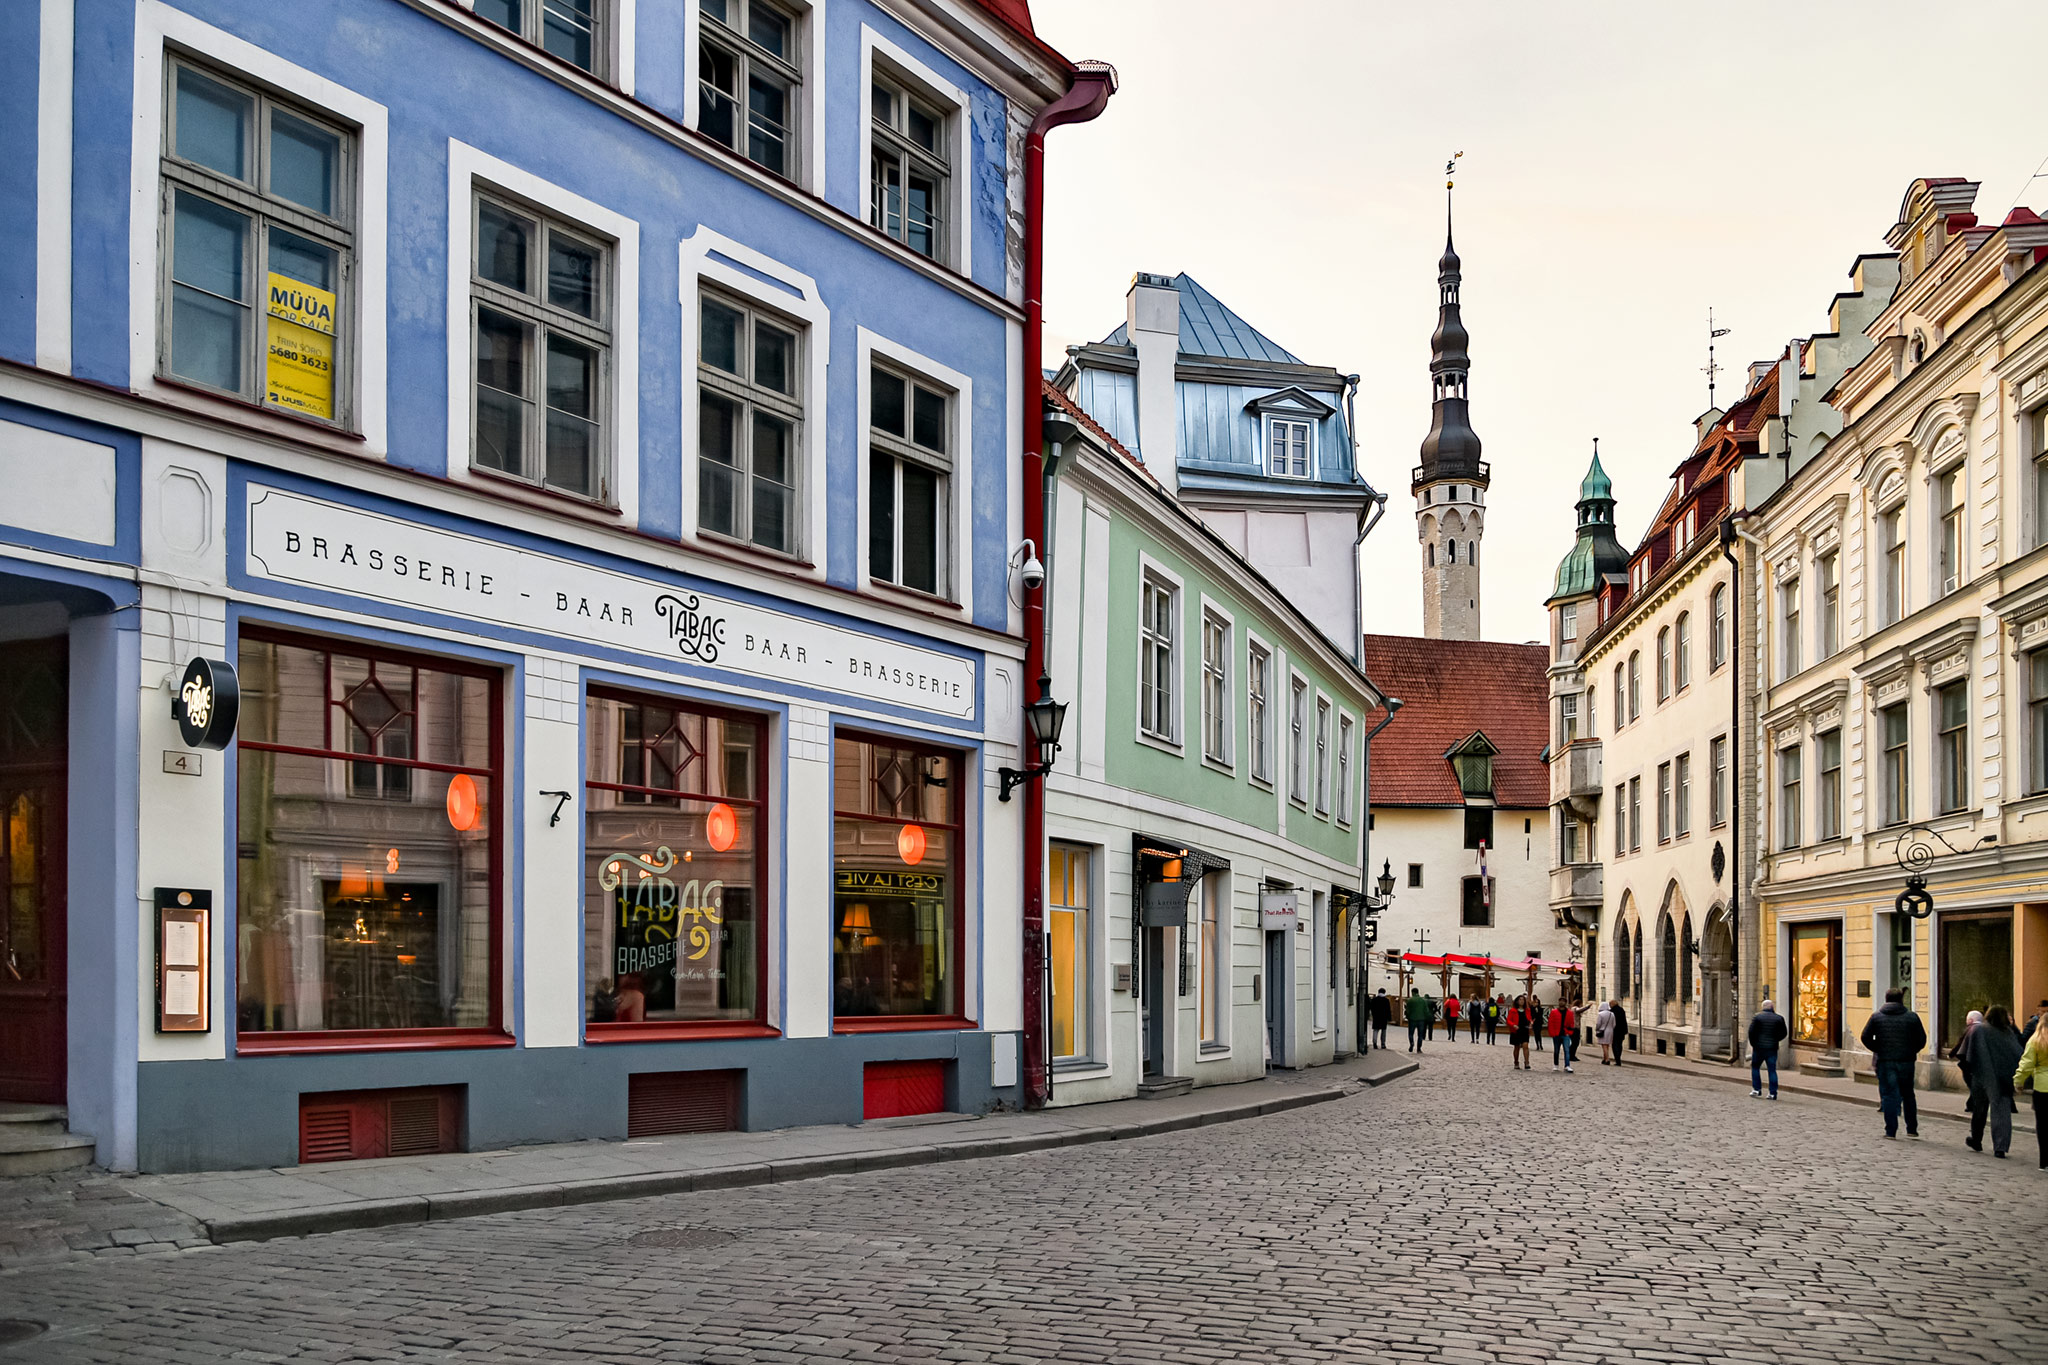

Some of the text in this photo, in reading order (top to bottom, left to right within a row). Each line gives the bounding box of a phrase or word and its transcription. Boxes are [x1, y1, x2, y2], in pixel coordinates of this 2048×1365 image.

[271, 286, 331, 322] MÜÜA
[270, 345, 298, 361] 5680
[301, 354, 329, 371] 3623
[285, 531, 494, 595] BRASSERIE
[556, 592, 634, 626] BAAR
[655, 594, 726, 663] TABAC
[745, 634, 807, 664] BAAR
[849, 658, 960, 698] BRASSERIE
[175, 756, 187, 770] 4
[539, 790, 572, 828] 7
[618, 929, 728, 975] BRASSERIE BAAR
